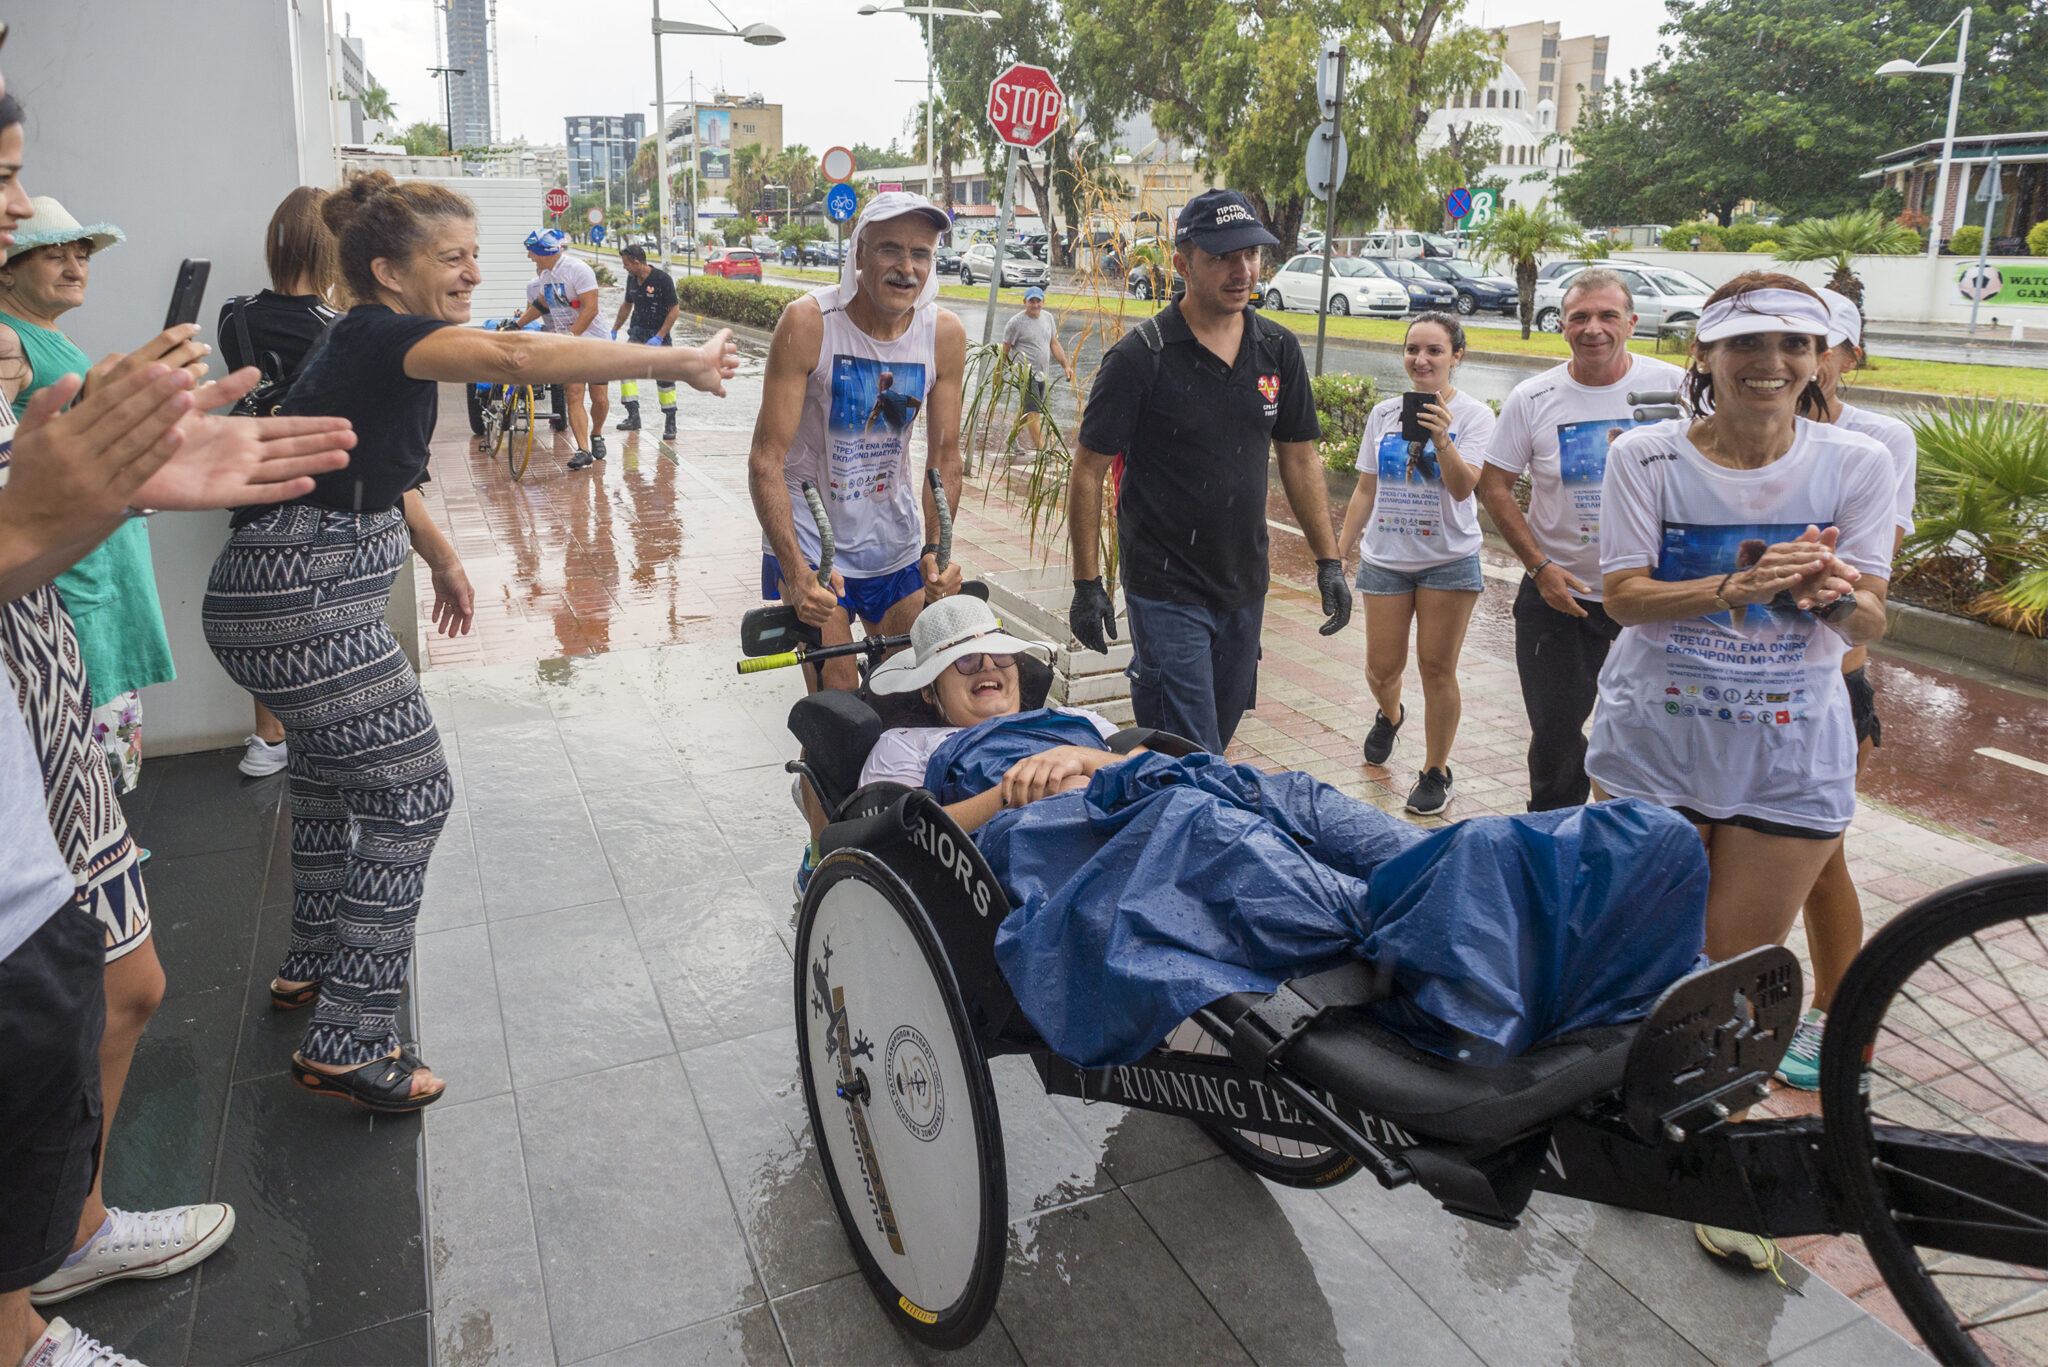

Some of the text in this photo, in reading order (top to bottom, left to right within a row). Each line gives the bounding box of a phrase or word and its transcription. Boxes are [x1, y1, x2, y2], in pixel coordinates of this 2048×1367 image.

[993, 82, 1060, 129] STOP
[546, 193, 569, 207] STOP
[1714, 639, 1737, 652] ΓΙΑ
[1740, 643, 1767, 653] ΕΝΑ
[1118, 1064, 1248, 1119] RUNNING
[845, 1106, 885, 1234] RUNNING
